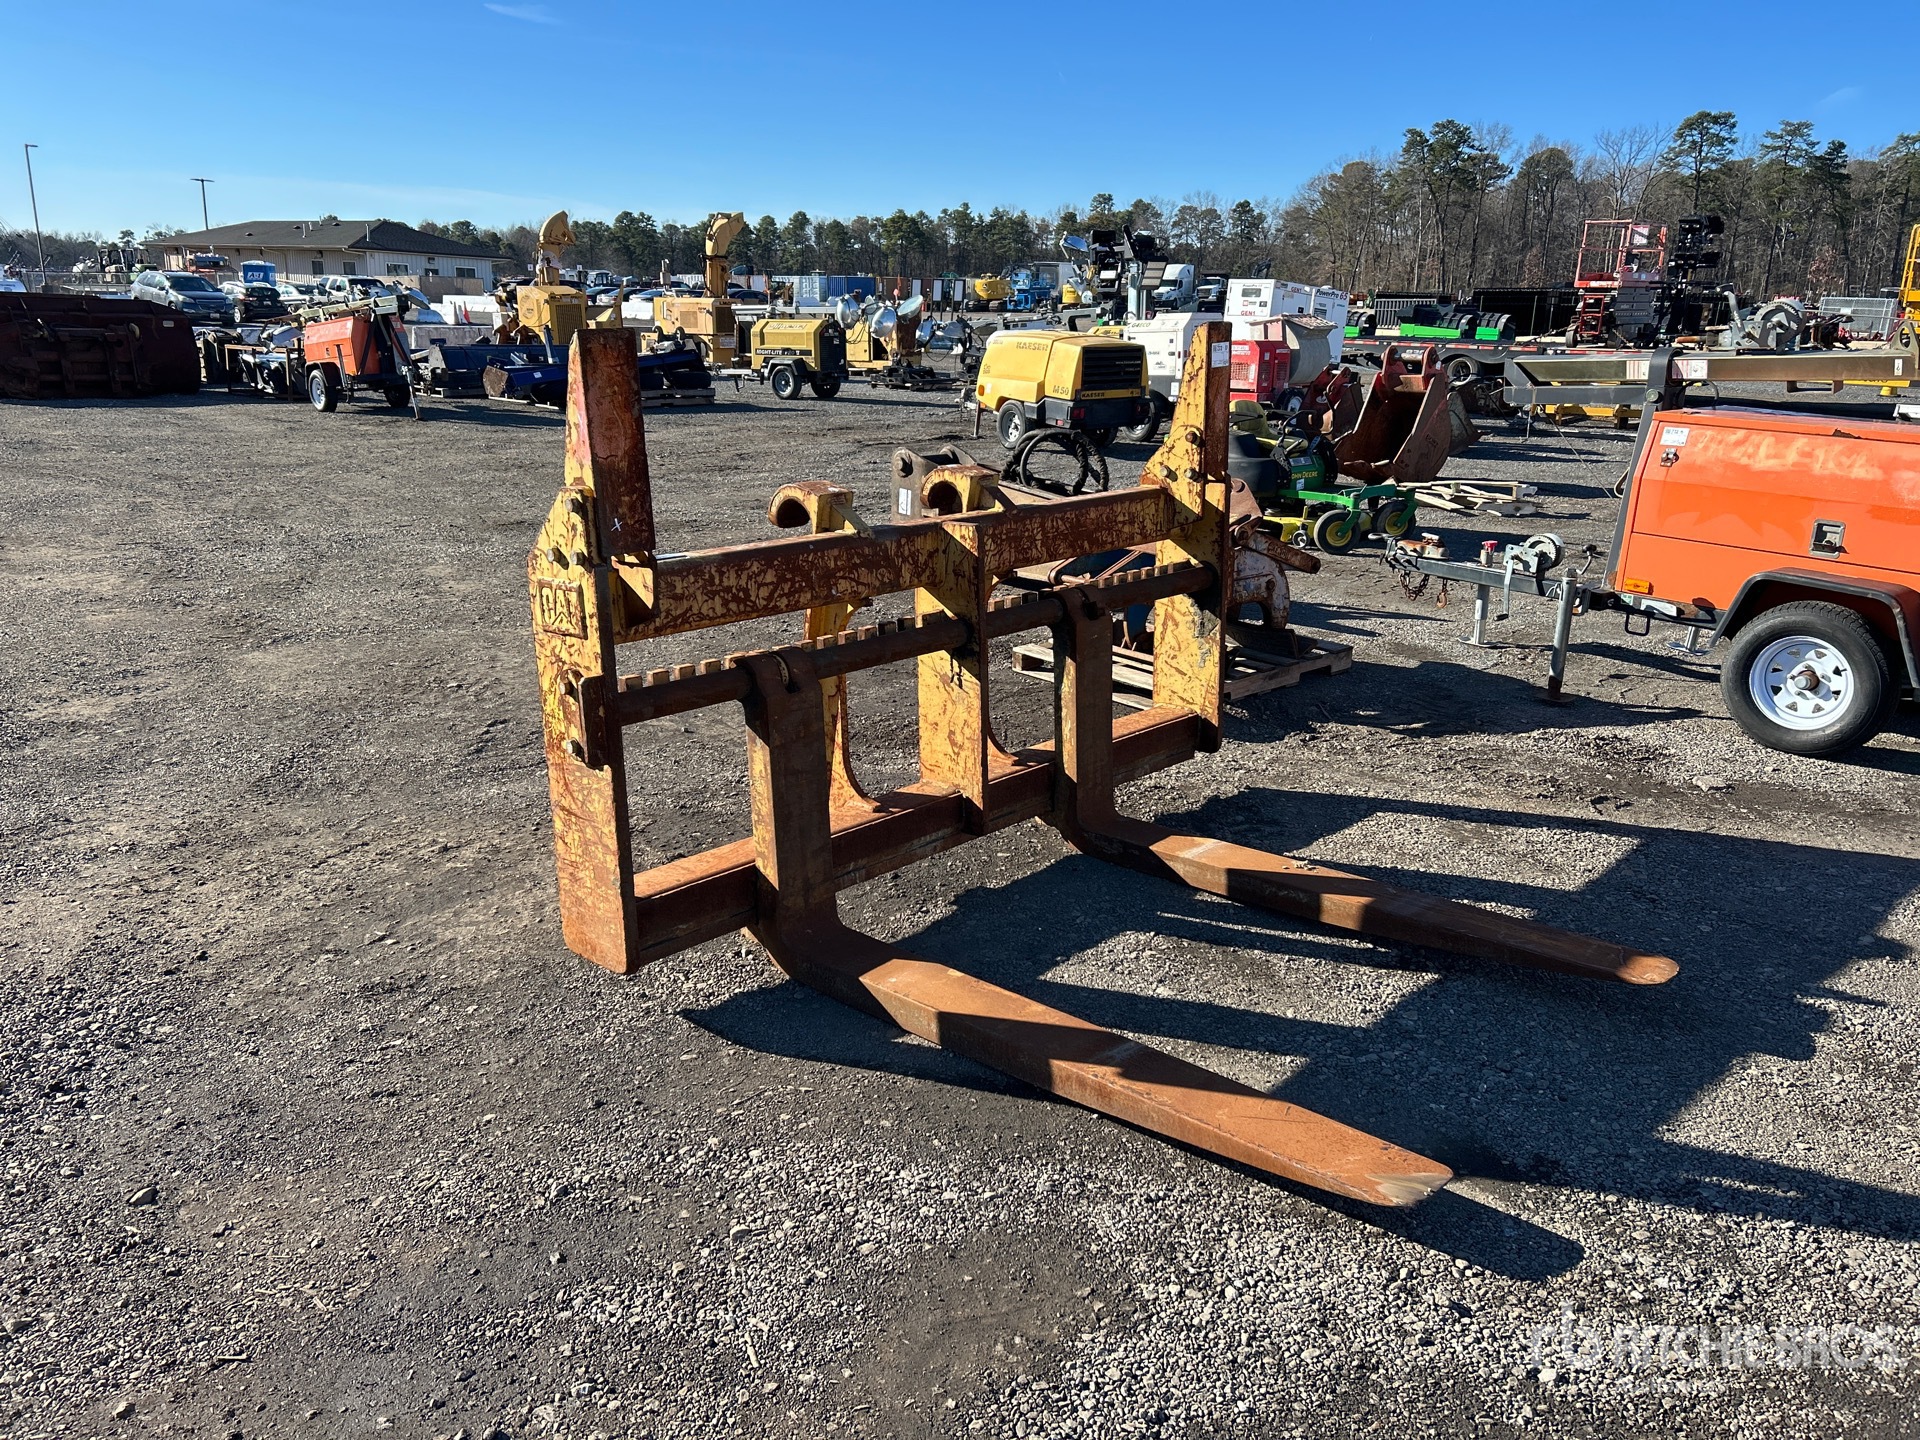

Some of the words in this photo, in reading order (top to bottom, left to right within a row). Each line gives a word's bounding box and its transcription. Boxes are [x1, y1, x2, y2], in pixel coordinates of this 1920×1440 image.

[1316, 289, 1339, 299] PowerPro
[1339, 291, 1348, 300] 65
[1016, 342, 1048, 352] KAESER
